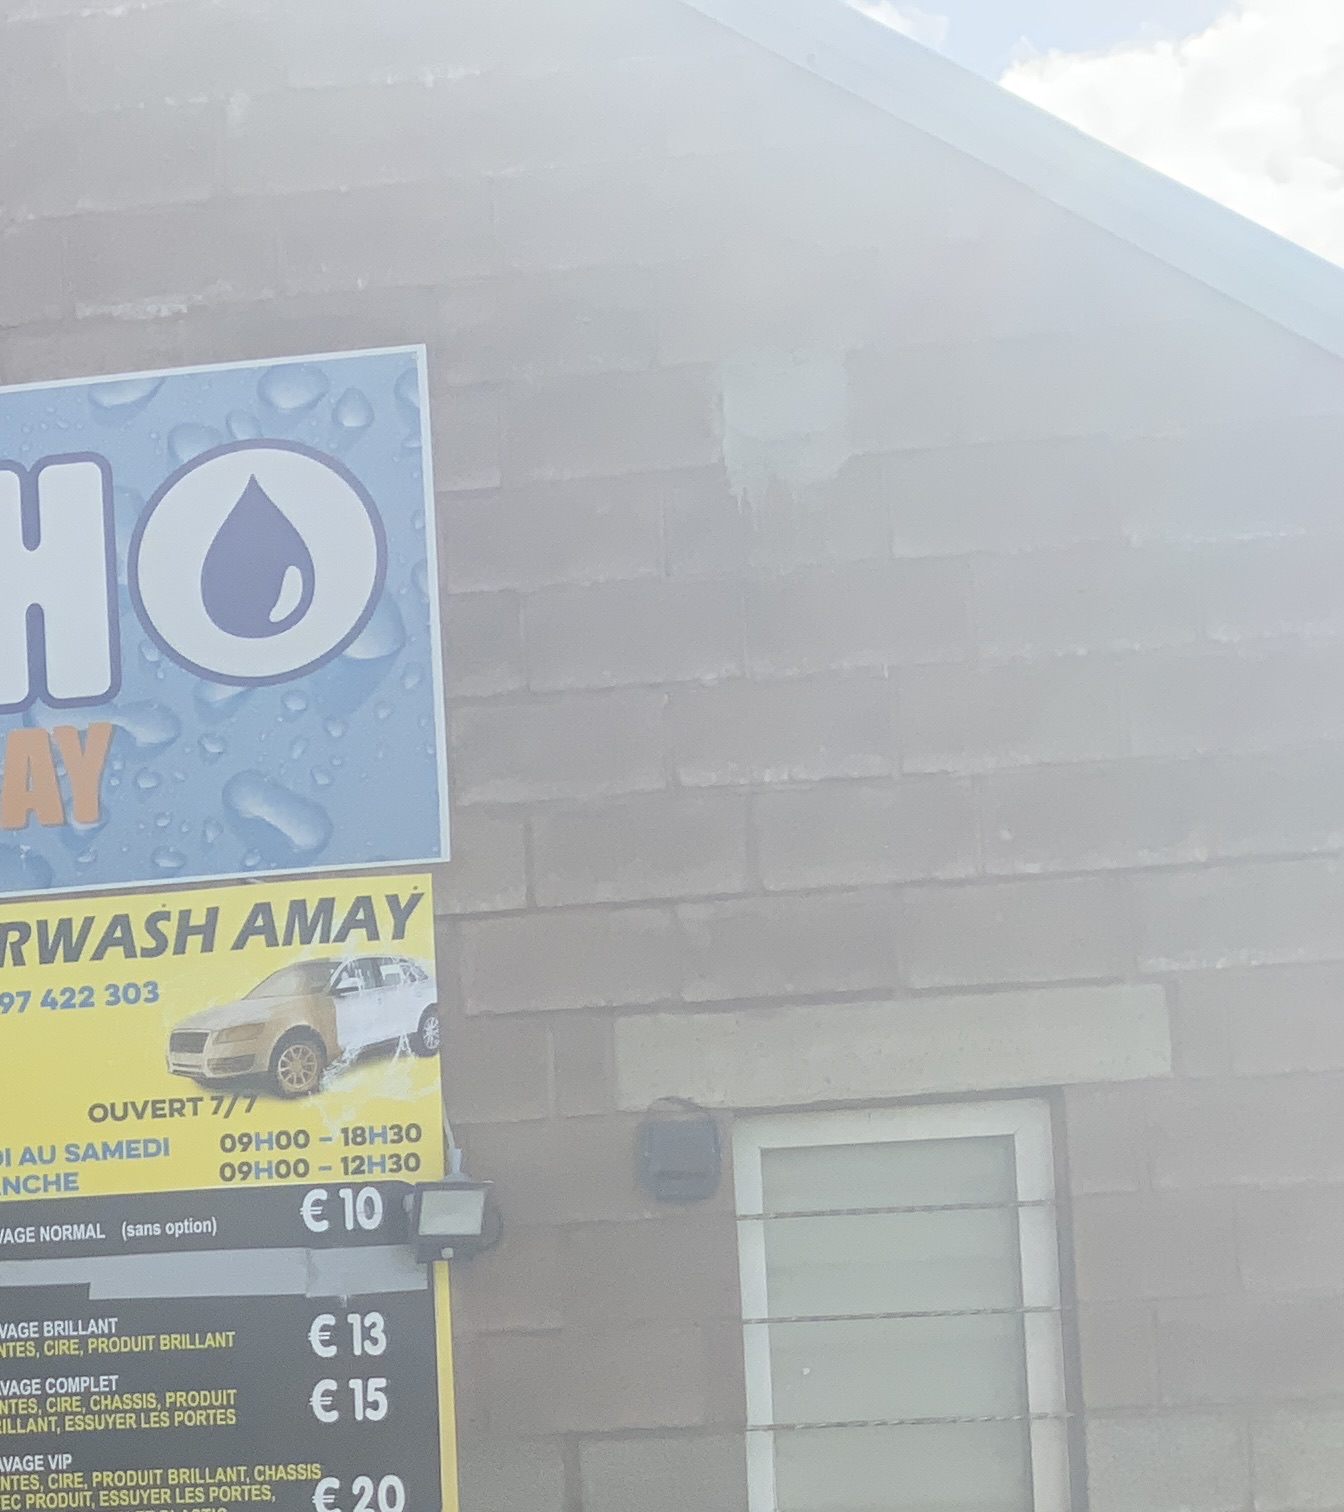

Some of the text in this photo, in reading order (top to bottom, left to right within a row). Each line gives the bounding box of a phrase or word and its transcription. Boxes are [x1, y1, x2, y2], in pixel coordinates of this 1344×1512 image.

[232, 893, 424, 951] AMAY
[41, 987, 97, 1011] 422
[105, 981, 159, 1007] 303
[88, 1095, 257, 1121] OUVERT 7/7
[19, 1146, 56, 1165] AU
[65, 1137, 169, 1163] SAMEDI
[219, 1129, 310, 1154] 09H00
[341, 1123, 422, 1148] 18H30
[219, 1158, 309, 1183] 09H00
[340, 1152, 421, 1177] 12H30
[40, 1224, 105, 1242] NORMAL
[122, 1221, 160, 1241] (sans
[166, 1216, 216, 1238] option)
[44, 1318, 118, 1336] BRILLANT
[44, 1338, 83, 1356] CIRE,
[88, 1336, 155, 1353] PRODUIT
[160, 1332, 235, 1350] BRILLANT
[46, 1375, 118, 1394] COMPLET
[46, 1396, 86, 1414] CIRE,
[90, 1392, 160, 1411] CHASSIS,
[166, 1390, 237, 1407] PRODUIT
[65, 1413, 136, 1431] ESSUYER
[141, 1412, 169, 1428] LES
[174, 1410, 236, 1426] PORTES
[48, 1454, 72, 1470] VIP
[48, 1472, 87, 1490] CIRE,
[93, 1470, 162, 1487] PRODUIT
[168, 1466, 249, 1485] BRILLANT,
[254, 1464, 321, 1481] CHASSIS
[26, 1492, 95, 1510] PRODUIT,
[100, 1489, 170, 1506] ESSUYER
[176, 1488, 204, 1503] LES
[209, 1485, 275, 1503] PORTES,
